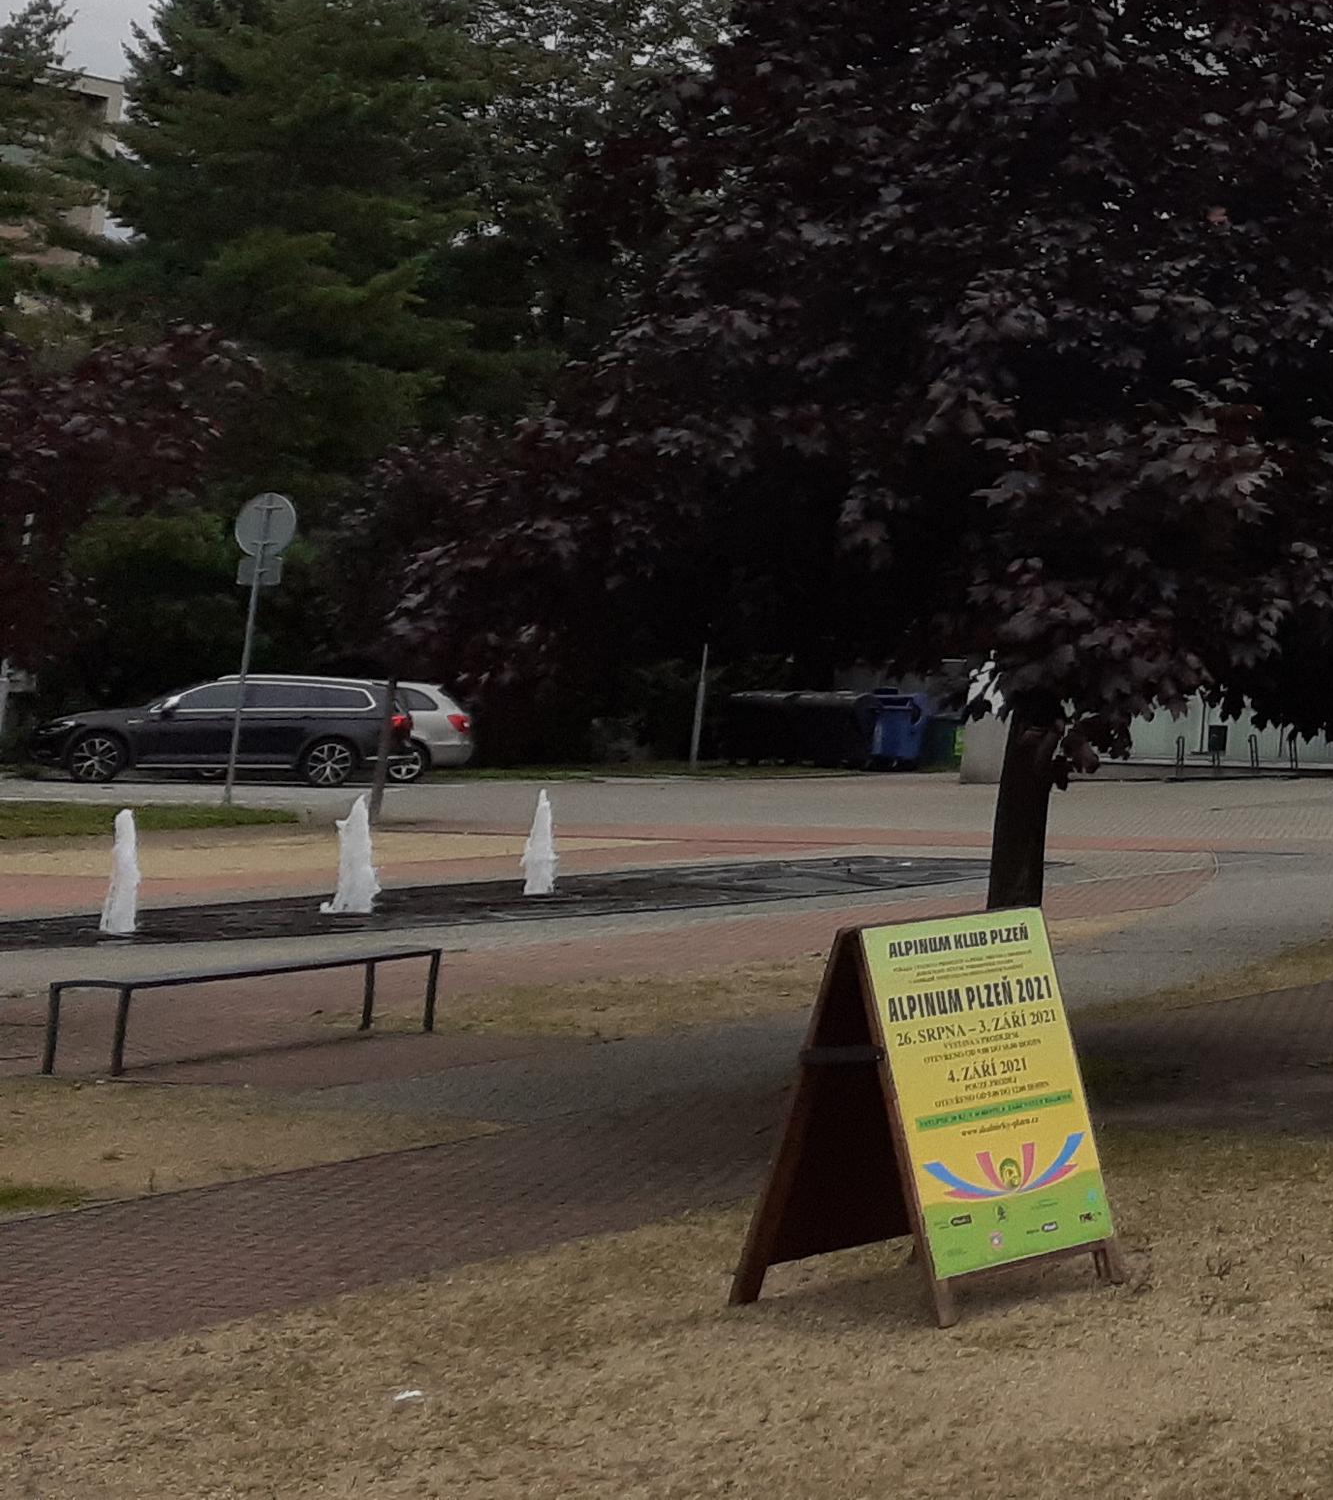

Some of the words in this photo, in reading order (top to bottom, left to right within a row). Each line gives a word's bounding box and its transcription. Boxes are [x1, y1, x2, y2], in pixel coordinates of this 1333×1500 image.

[888, 935, 952, 958] ALPINUM
[954, 931, 988, 950] KLUB
[990, 922, 1029, 945] PLZEŇ
[888, 988, 964, 1023] ALPINUM
[966, 975, 1014, 1011] PLZEŇ
[1016, 975, 1053, 1004] 2021
[993, 1009, 1027, 1031] ZÁŘÍ
[1030, 1009, 1057, 1026] 2021
[962, 1060, 997, 1081] ZÁŘÍ
[1000, 1057, 1027, 1074] 2021
